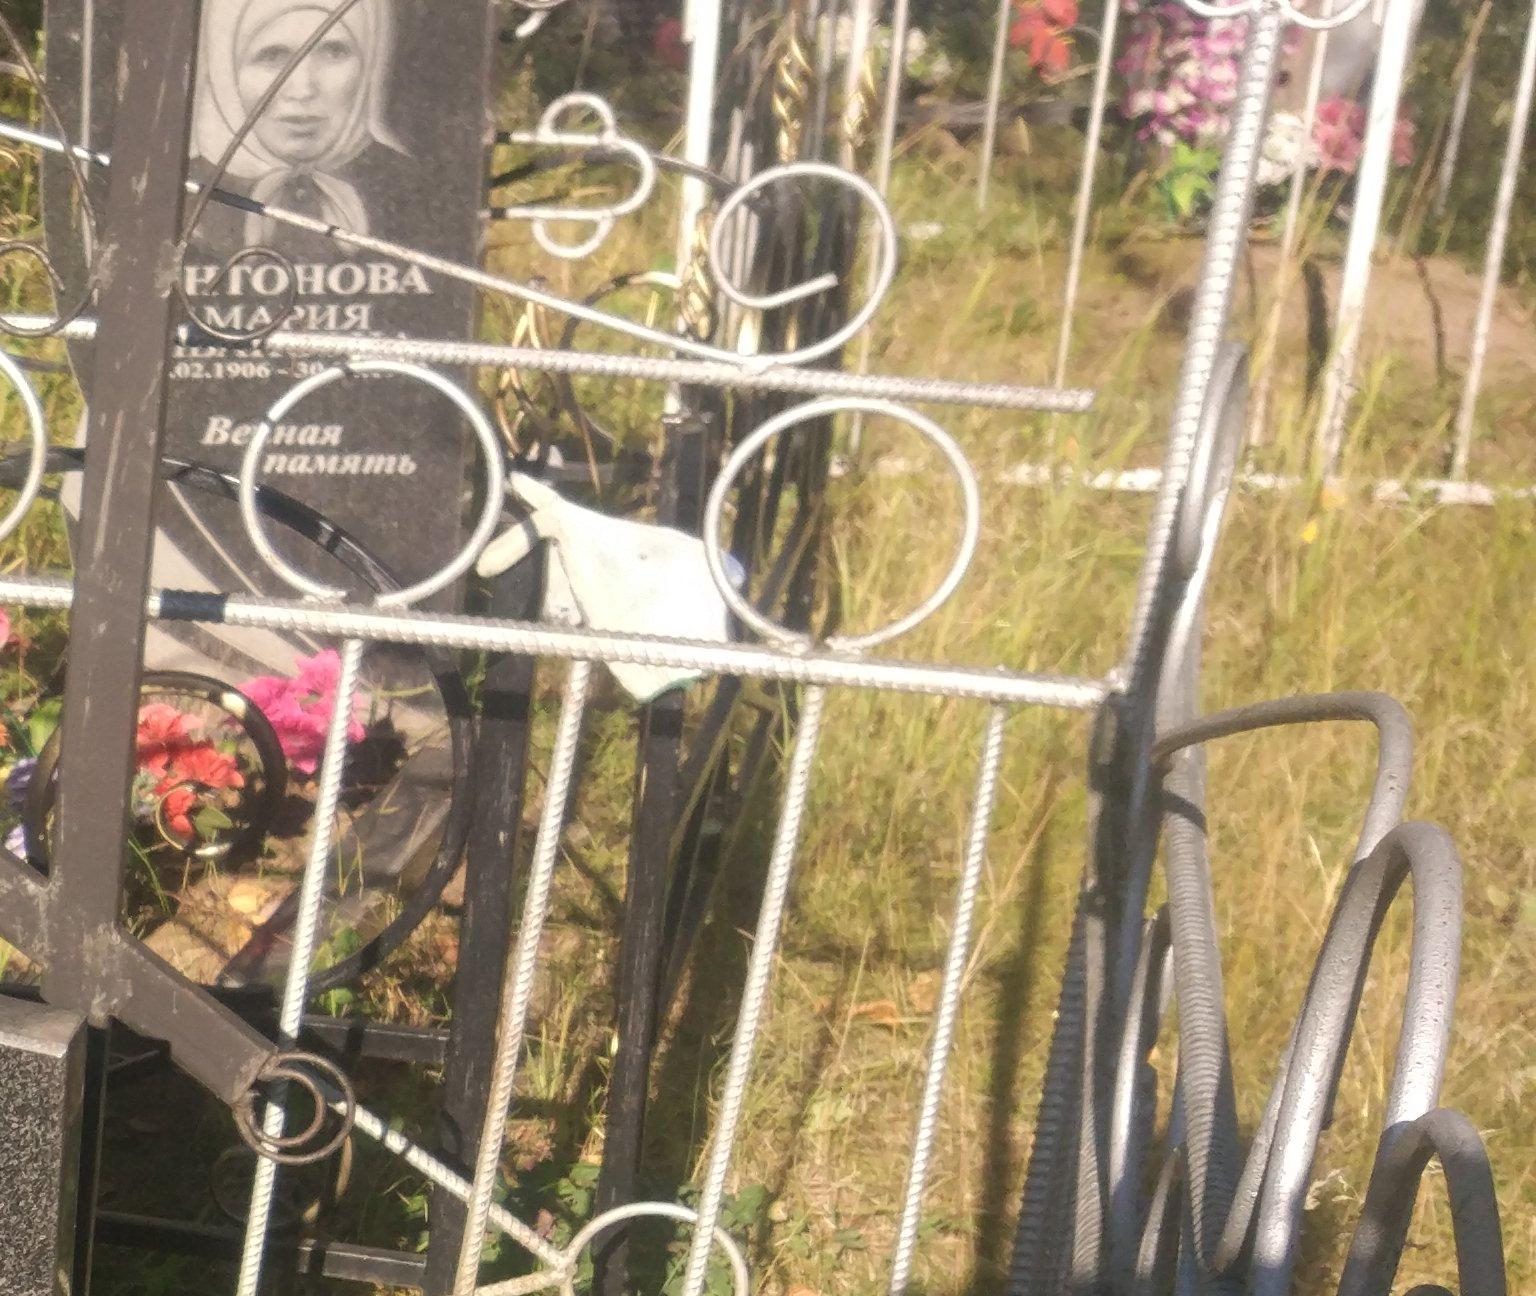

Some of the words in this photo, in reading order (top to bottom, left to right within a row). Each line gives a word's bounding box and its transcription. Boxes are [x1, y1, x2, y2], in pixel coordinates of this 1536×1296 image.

[184, 262, 434, 297] НТОНОВА
[203, 303, 372, 331] МАРИЯ
[199, 414, 344, 446] Веная
[263, 453, 418, 475] память
